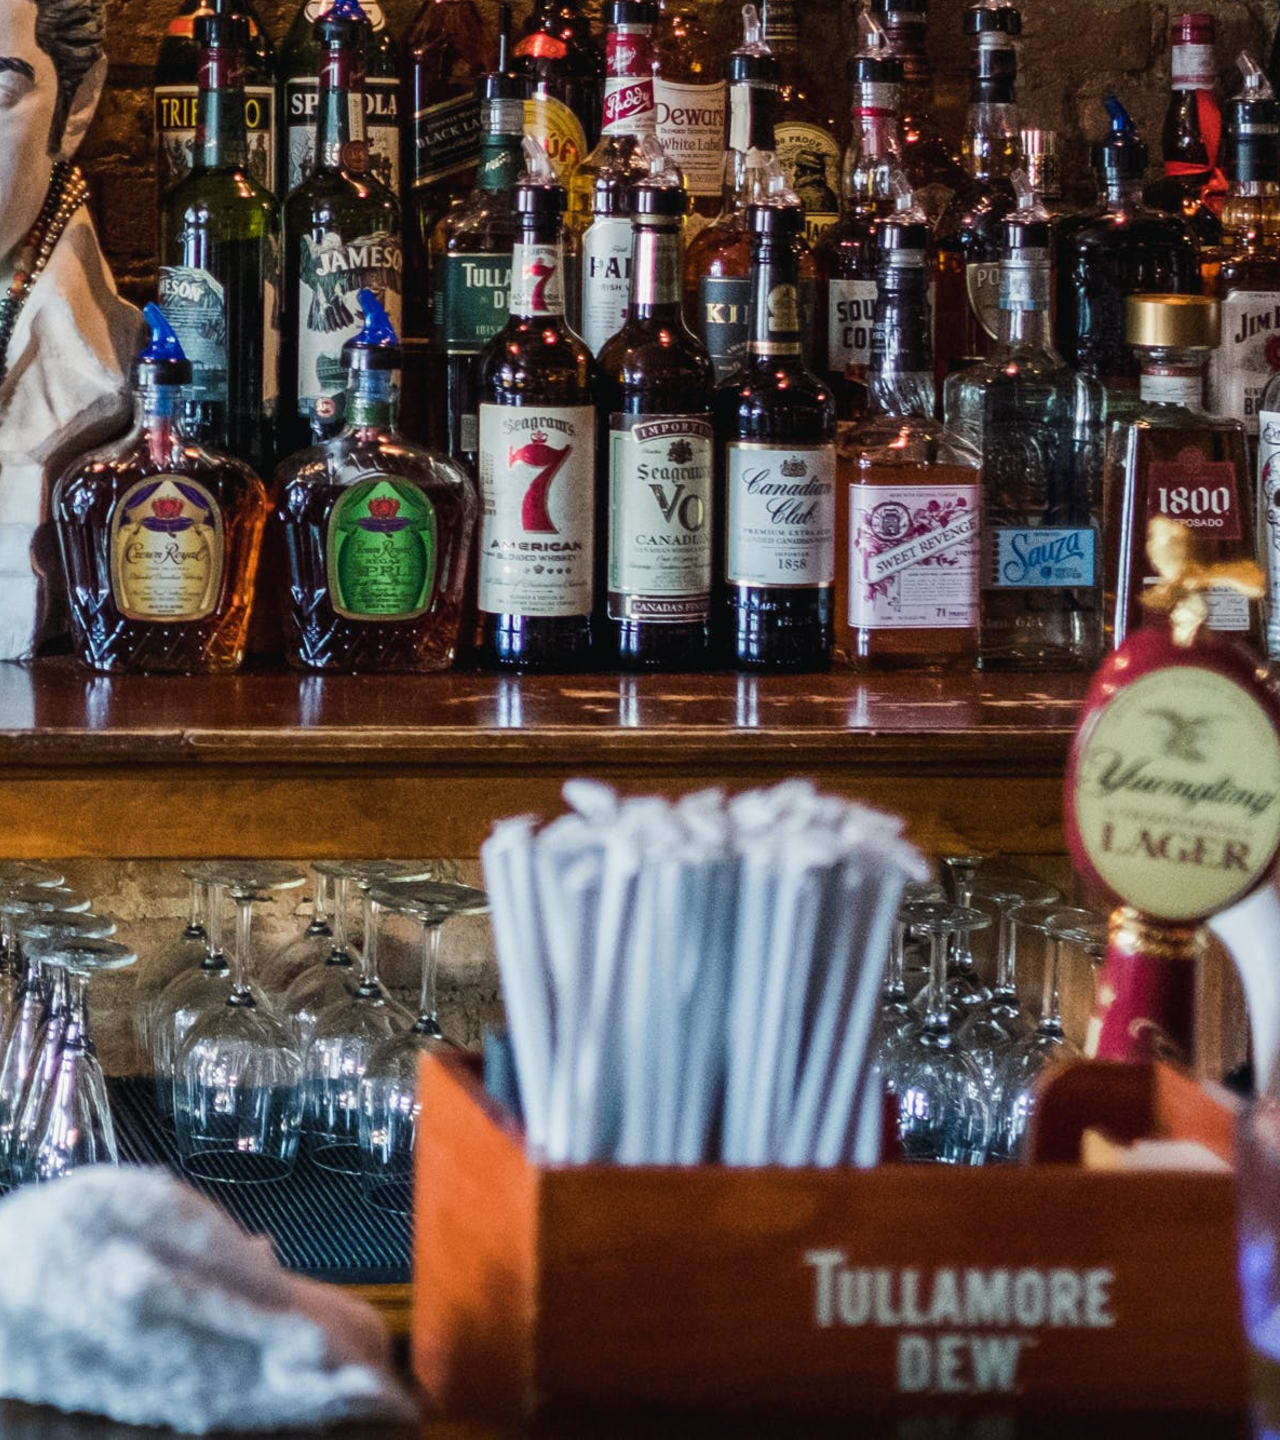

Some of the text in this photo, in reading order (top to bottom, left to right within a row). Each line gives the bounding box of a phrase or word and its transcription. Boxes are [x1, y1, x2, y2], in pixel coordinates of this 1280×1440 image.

[607, 84, 651, 118] Paddy
[525, 261, 556, 310] 7
[502, 416, 576, 436] Seagram's
[508, 444, 573, 534] 7
[648, 484, 704, 532] VO
[1158, 486, 1229, 514] 1800
[490, 539, 583, 552] AMERICAN
[777, 558, 807, 570] 1858
[875, 515, 977, 574] SWEET REVENGE
[1003, 530, 1083, 582] Sauza
[1100, 821, 1252, 872] LAGER
[804, 1249, 1119, 1328] TULLAMORE
[897, 1333, 1023, 1394] DEW
